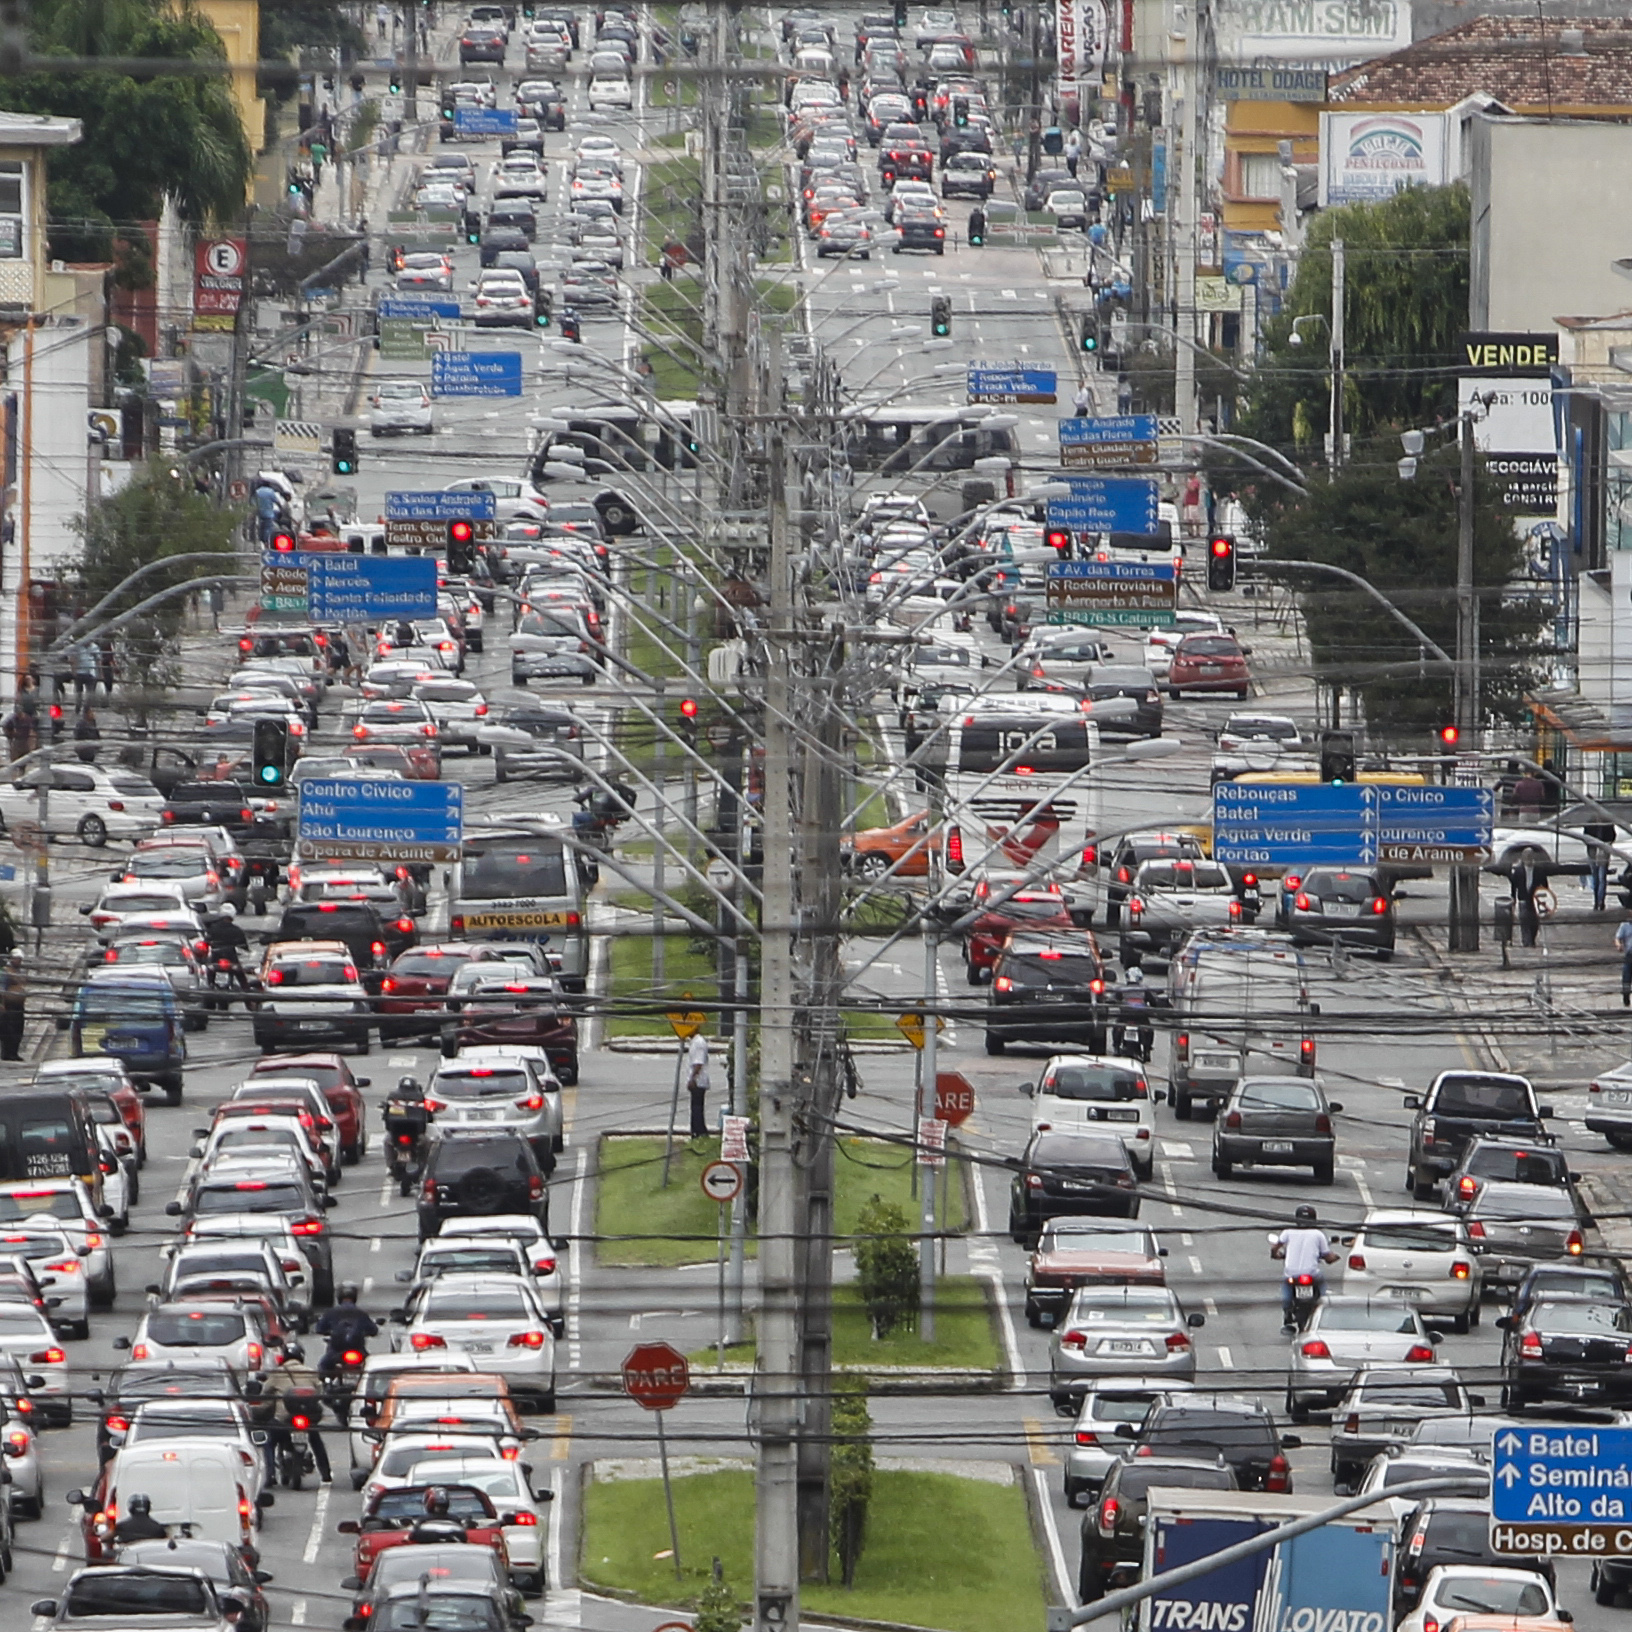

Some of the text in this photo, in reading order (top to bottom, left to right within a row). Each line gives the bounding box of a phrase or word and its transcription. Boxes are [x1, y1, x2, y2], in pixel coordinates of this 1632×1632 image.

[1469, 387, 1514, 405] Áea:
[1049, 506, 1082, 518] Capão
[325, 559, 358, 572] Batel
[1064, 564, 1082, 576] Av.
[1088, 564, 1111, 576] das
[1064, 579, 1163, 593] Rodoferroviária
[302, 783, 414, 799] Centro Cívico
[1216, 787, 1445, 803] Rebouças Cívico
[302, 801, 336, 815] Ahú
[1216, 806, 1259, 821] Batel
[302, 823, 416, 841] São Lourenço
[1216, 822, 1446, 843] Água Verde ourenço
[1216, 846, 1464, 861] Portão de Arame
[469, 913, 561, 926] AUTOESCOLA
[935, 1091, 970, 1110] ARE
[625, 1366, 684, 1388] PARE
[1528, 1434, 1599, 1458] Batel
[1527, 1493, 1582, 1518] Alto
[1590, 1493, 1625, 1518] da
[1494, 1526, 1568, 1554] Hosp.
[1572, 1528, 1607, 1551] de
[1153, 1600, 1249, 1631] TRANS
